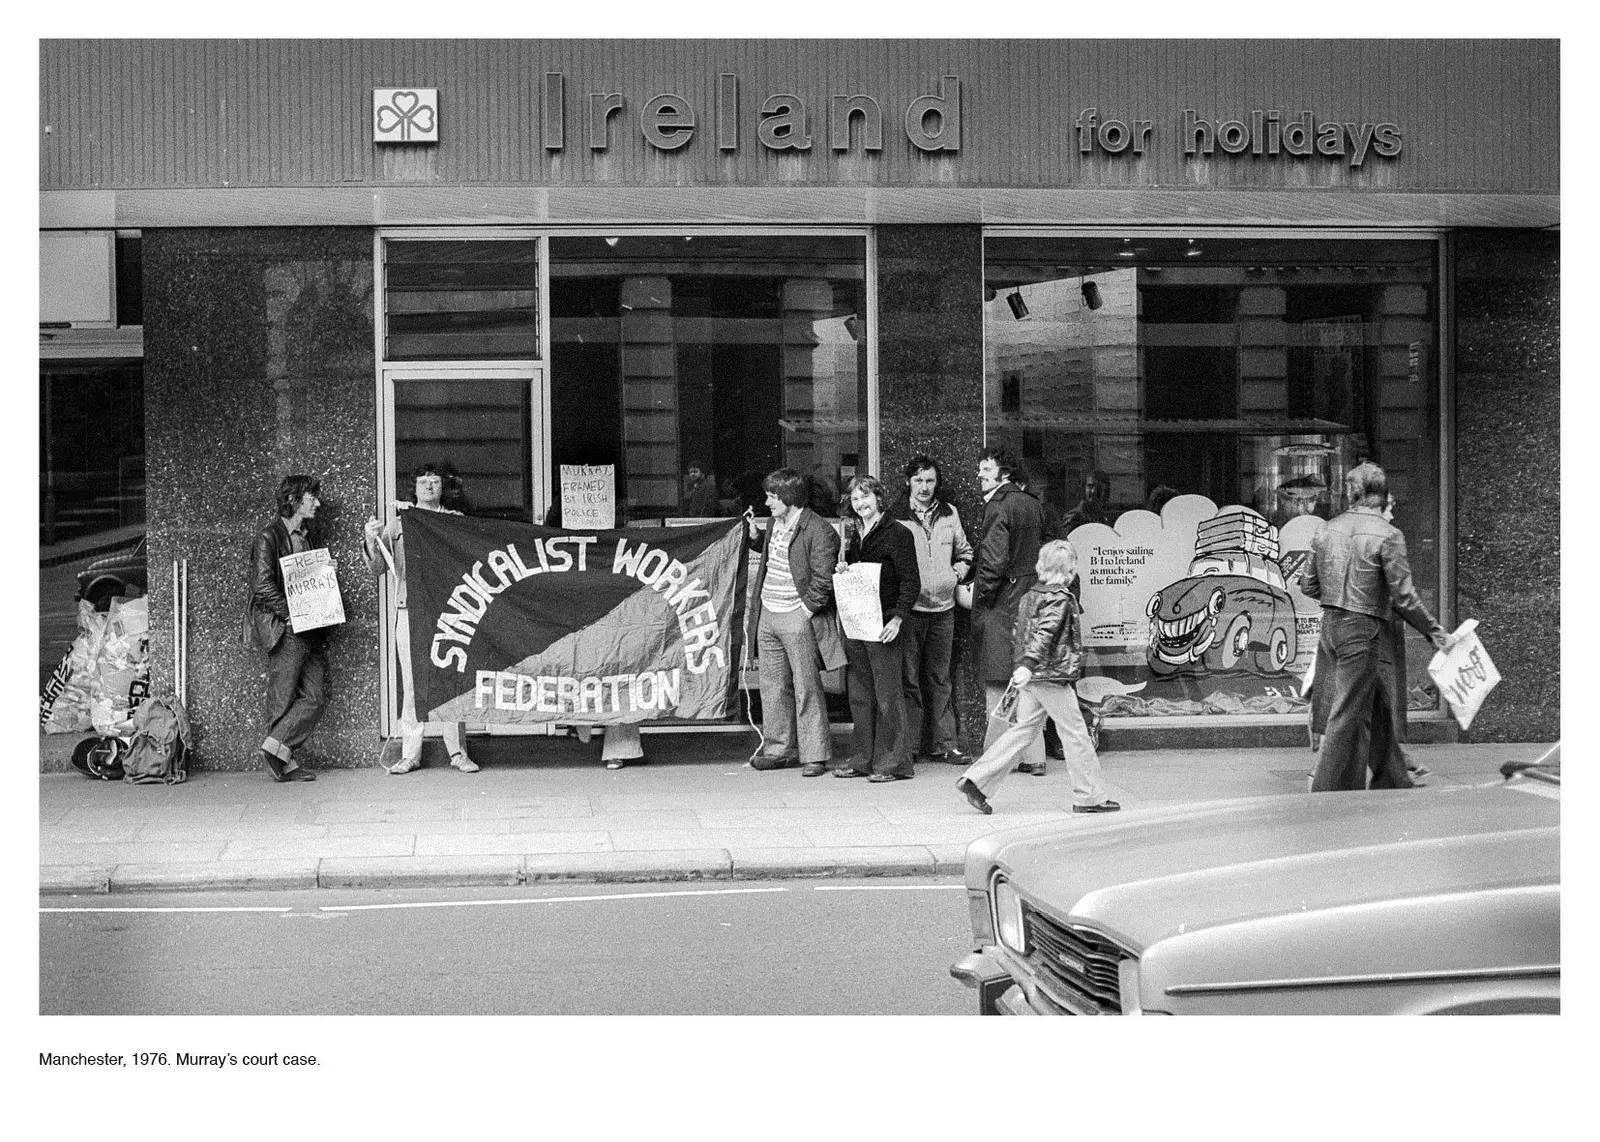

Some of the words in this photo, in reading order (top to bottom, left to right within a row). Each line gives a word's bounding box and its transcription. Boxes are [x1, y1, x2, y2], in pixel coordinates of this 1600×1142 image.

[544, 72, 960, 151] Ireland
[1075, 107, 1152, 153] for
[1184, 109, 1402, 166] holidays
[563, 480, 605, 492] FRAMED
[564, 495, 577, 503] BY
[583, 493, 608, 504] IRISH
[564, 508, 599, 517] POLICE
[1101, 546, 1124, 557] enjoy
[1126, 546, 1154, 557] sailing
[283, 552, 325, 568] FREE
[1105, 557, 1114, 565] to
[1115, 555, 1146, 565] Ireland
[1090, 567, 1099, 575] as
[1100, 566, 1124, 575] much
[1125, 567, 1135, 575] as
[287, 571, 337, 597] MURRAYS
[1090, 576, 1104, 585] the
[430, 536, 597, 672] SYNDICALIST
[612, 538, 726, 674] WORKERS
[474, 668, 681, 713] FEDERATION
